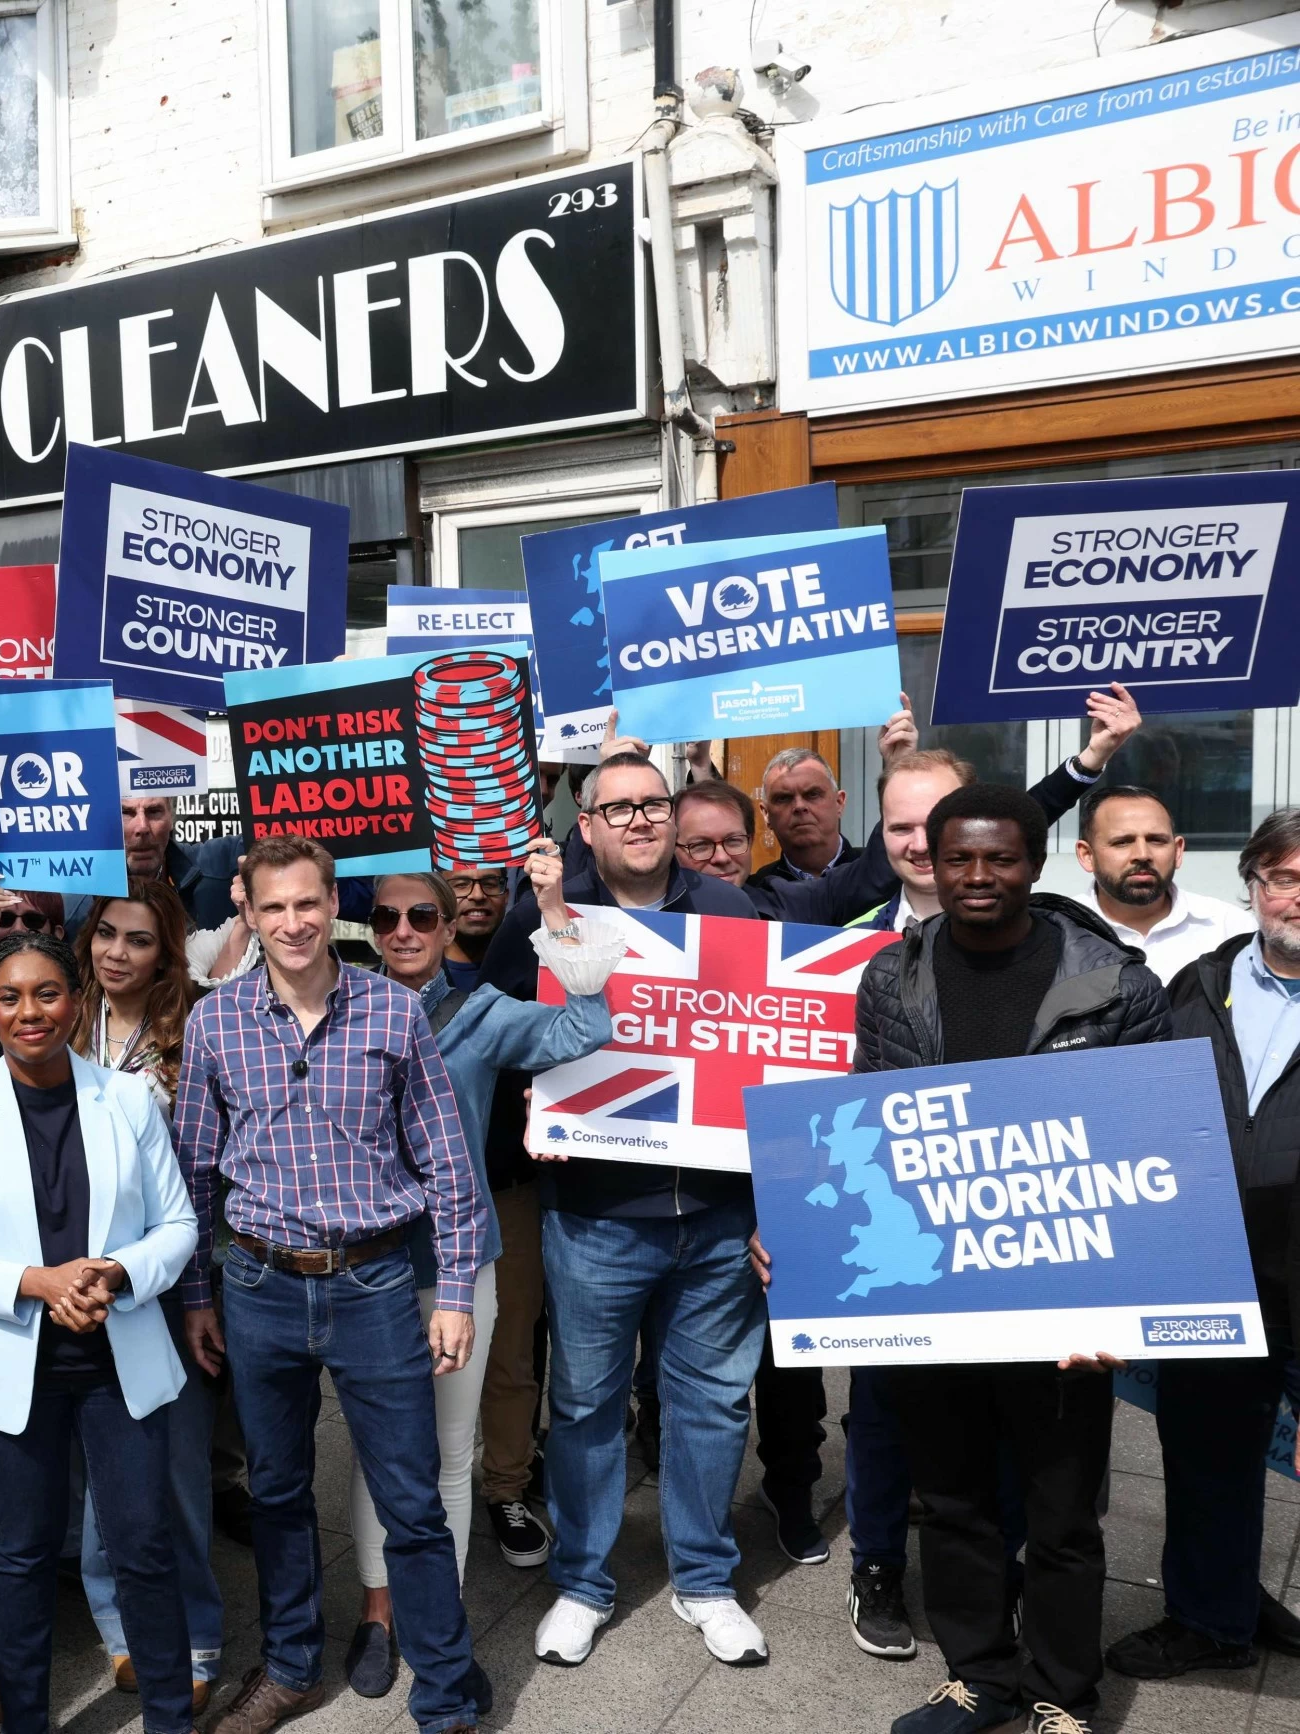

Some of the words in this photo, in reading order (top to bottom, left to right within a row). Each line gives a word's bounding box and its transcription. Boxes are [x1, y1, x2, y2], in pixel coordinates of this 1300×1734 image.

[822, 122, 971, 172] Craftsmanship
[978, 112, 1027, 142] with
[1033, 101, 1088, 133] Care
[1096, 85, 1153, 118] from
[1158, 80, 1190, 101] an
[1196, 50, 1300, 92] establis
[1233, 118, 1268, 142] Be
[547, 182, 619, 220] 293
[0, 227, 566, 465] CLEANERS
[141, 508, 281, 558] STRONGER
[1051, 522, 1240, 555] STRONGER
[121, 531, 296, 591] ECONOMY
[1023, 549, 1260, 589] ECONOMY
[665, 563, 827, 628] VOTE
[135, 594, 277, 641] STRONGER
[417, 612, 515, 631] RE-ELECT
[1036, 610, 1222, 641] STRONGER
[121, 621, 289, 670] COUNTRY
[619, 603, 891, 673] CONSERVATIVE
[1017, 636, 1235, 675] COUNTRY
[720, 698, 757, 709] JASON
[760, 694, 797, 705] PERRY
[242, 714, 333, 744] DON'T
[337, 708, 403, 738] RISK
[137, 769, 187, 778] STRONGER
[247, 740, 407, 777] ANOTHER
[133, 775, 191, 786] ECONOMY
[249, 774, 413, 815] LABOUR
[1, 804, 91, 833] PERRY
[176, 794, 204, 815] ALL
[209, 793, 240, 815] CUR
[175, 820, 216, 842] SOFT
[253, 812, 414, 839] BANKRUPTCY
[50, 857, 94, 877] MAY
[630, 983, 827, 1025] STRONGER
[611, 1013, 679, 1048] GH
[881, 1082, 972, 1136] GET
[571, 1129, 669, 1150] Conservatives
[889, 1116, 1090, 1183] BRITAIN
[917, 1156, 1179, 1226] WORKING
[951, 1214, 1115, 1273] AGAIN
[819, 1333, 933, 1350] Conservatives
[1147, 1328, 1238, 1342] ECONOMY
[1152, 1319, 1230, 1331] STRONGER
